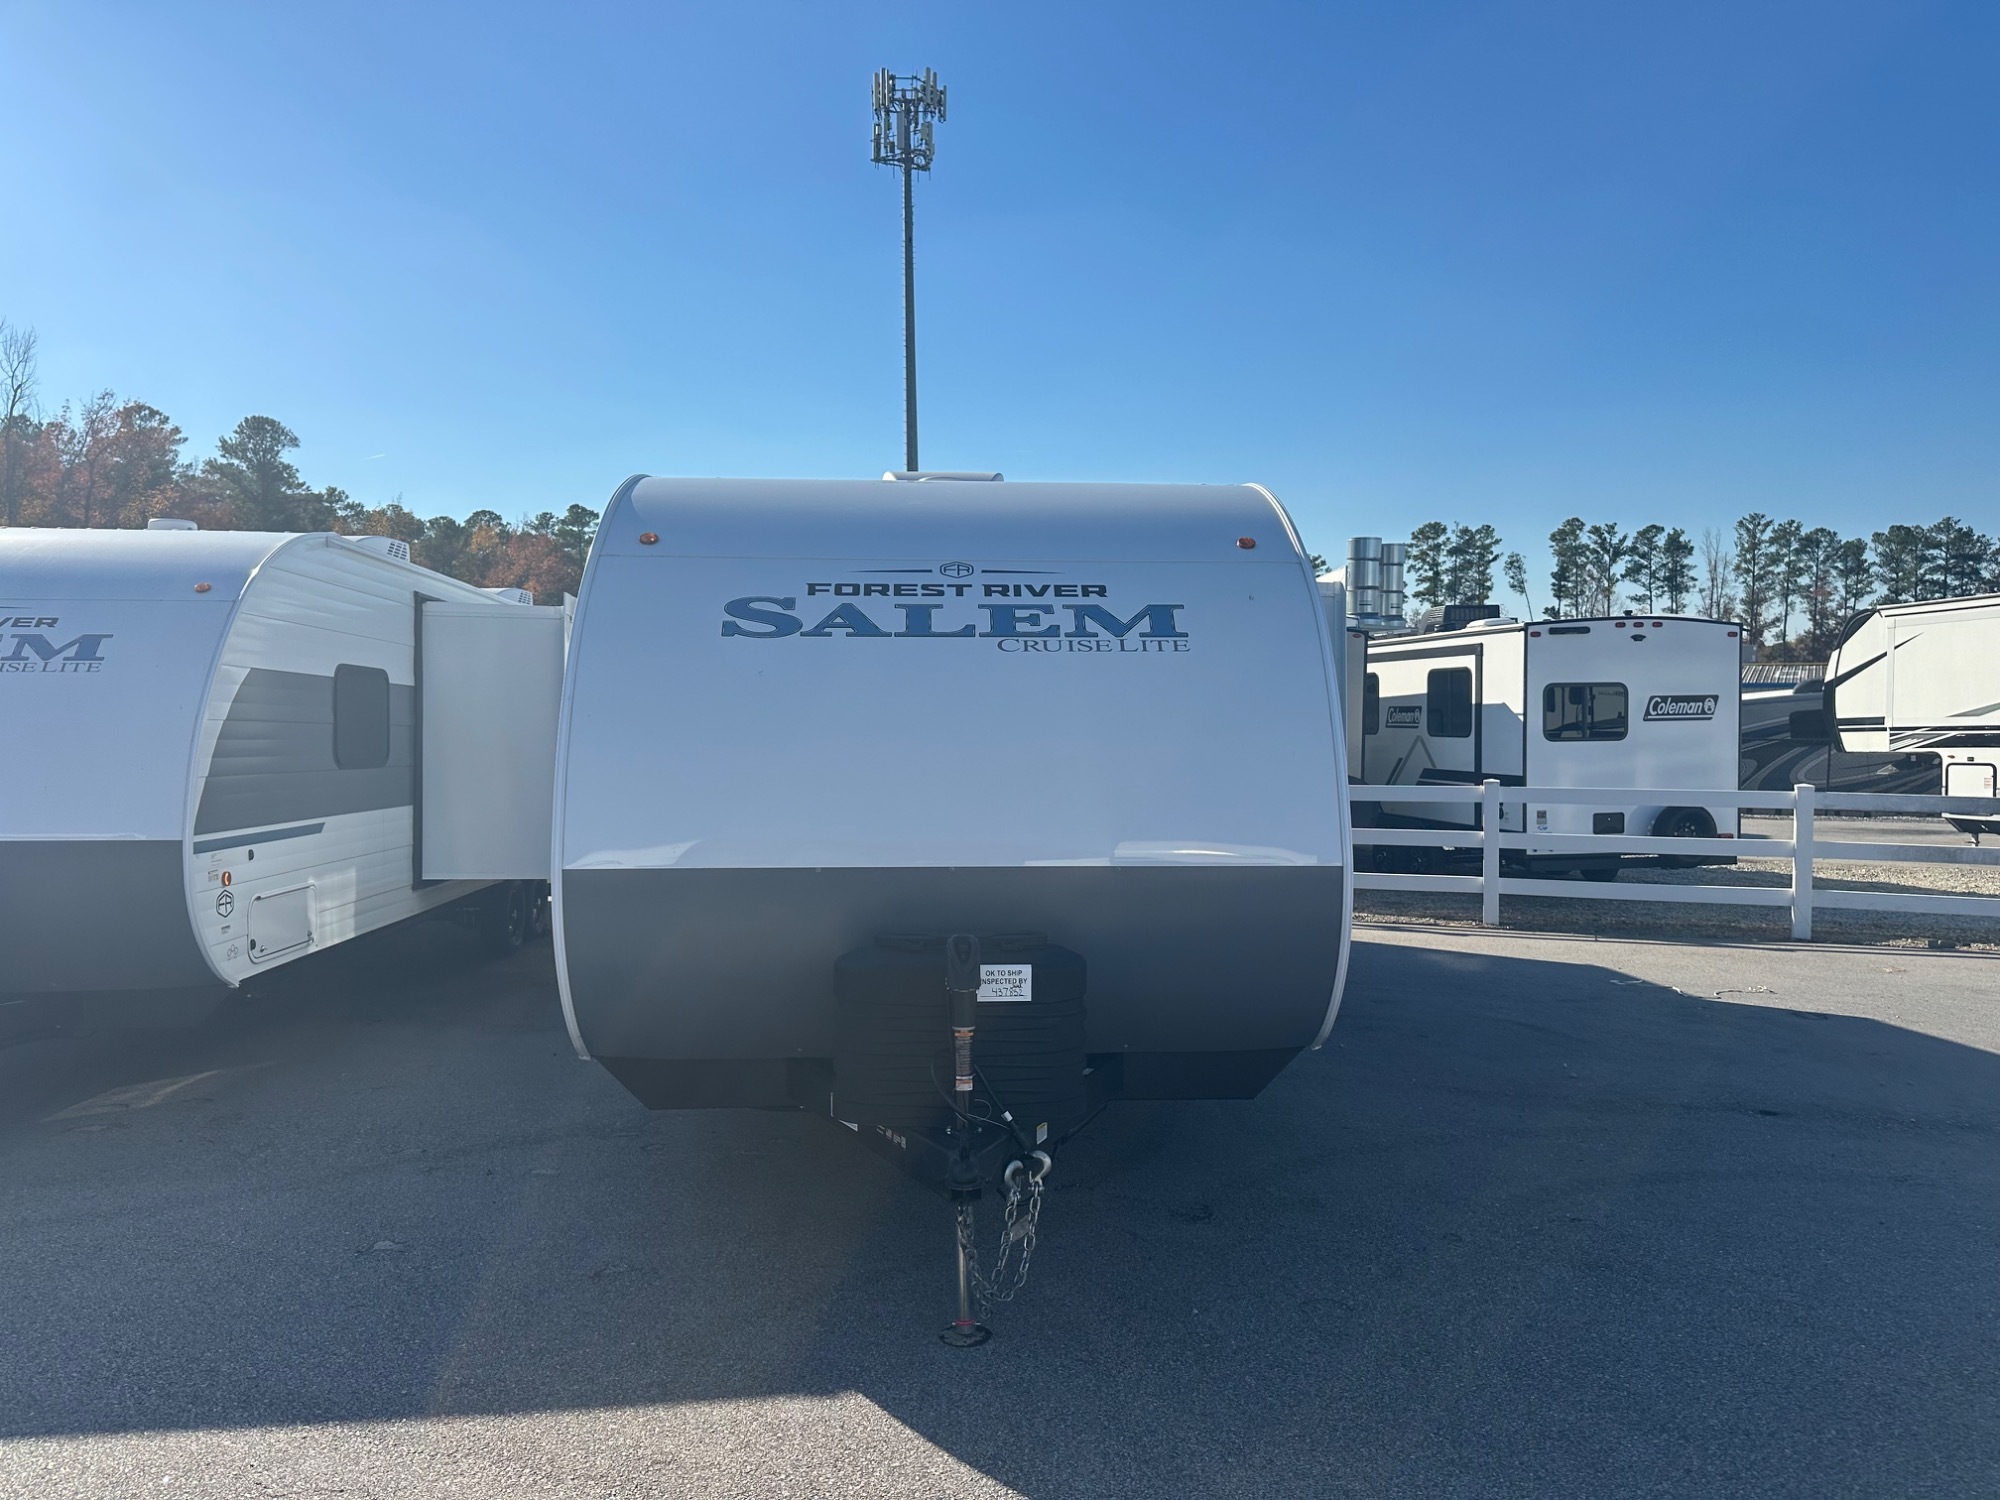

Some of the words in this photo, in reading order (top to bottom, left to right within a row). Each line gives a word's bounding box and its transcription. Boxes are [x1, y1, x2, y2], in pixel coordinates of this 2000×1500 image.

[806, 583, 973, 597] FOREST
[981, 583, 1108, 598] RIVER
[721, 595, 1189, 639] SALEM
[0, 633, 114, 662] M
[1649, 697, 1703, 716] Coleman
